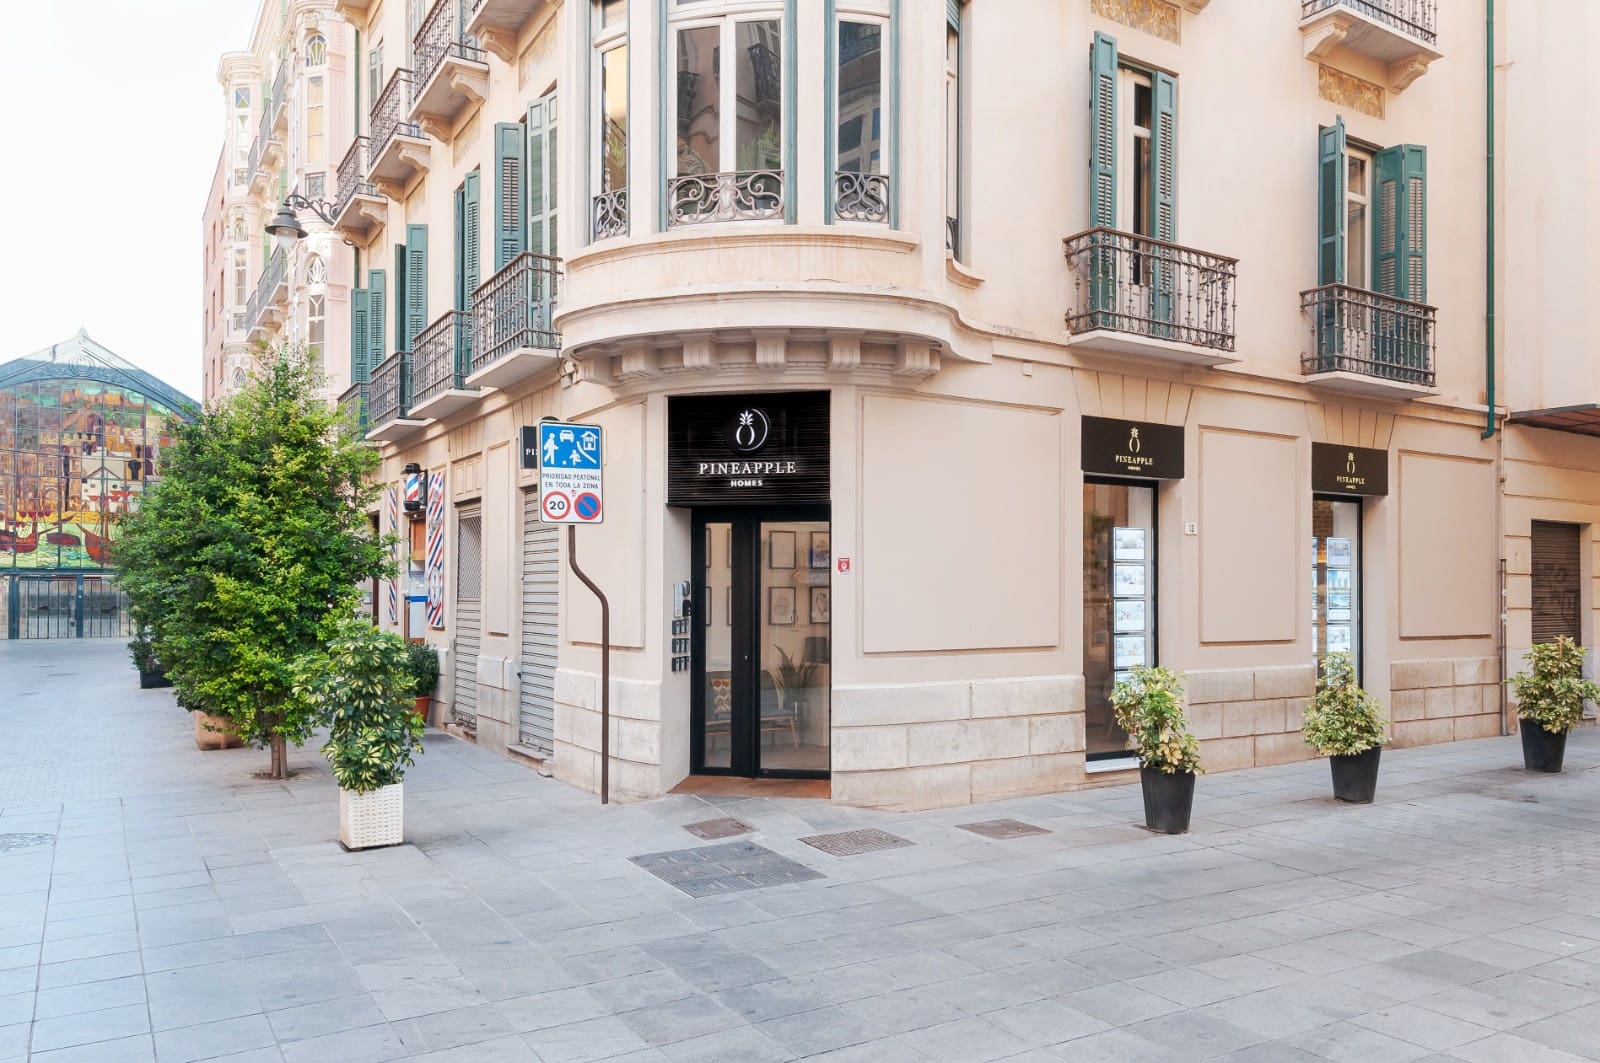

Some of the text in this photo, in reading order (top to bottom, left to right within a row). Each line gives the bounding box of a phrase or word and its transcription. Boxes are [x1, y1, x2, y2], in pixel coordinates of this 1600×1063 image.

[525, 448, 537, 456] PI
[1115, 454, 1153, 466] PINEAPPLE
[699, 461, 796, 475] PINEAPPLE
[542, 472, 600, 481] PRIORIDAD PEATONAL
[549, 501, 565, 510] 20
